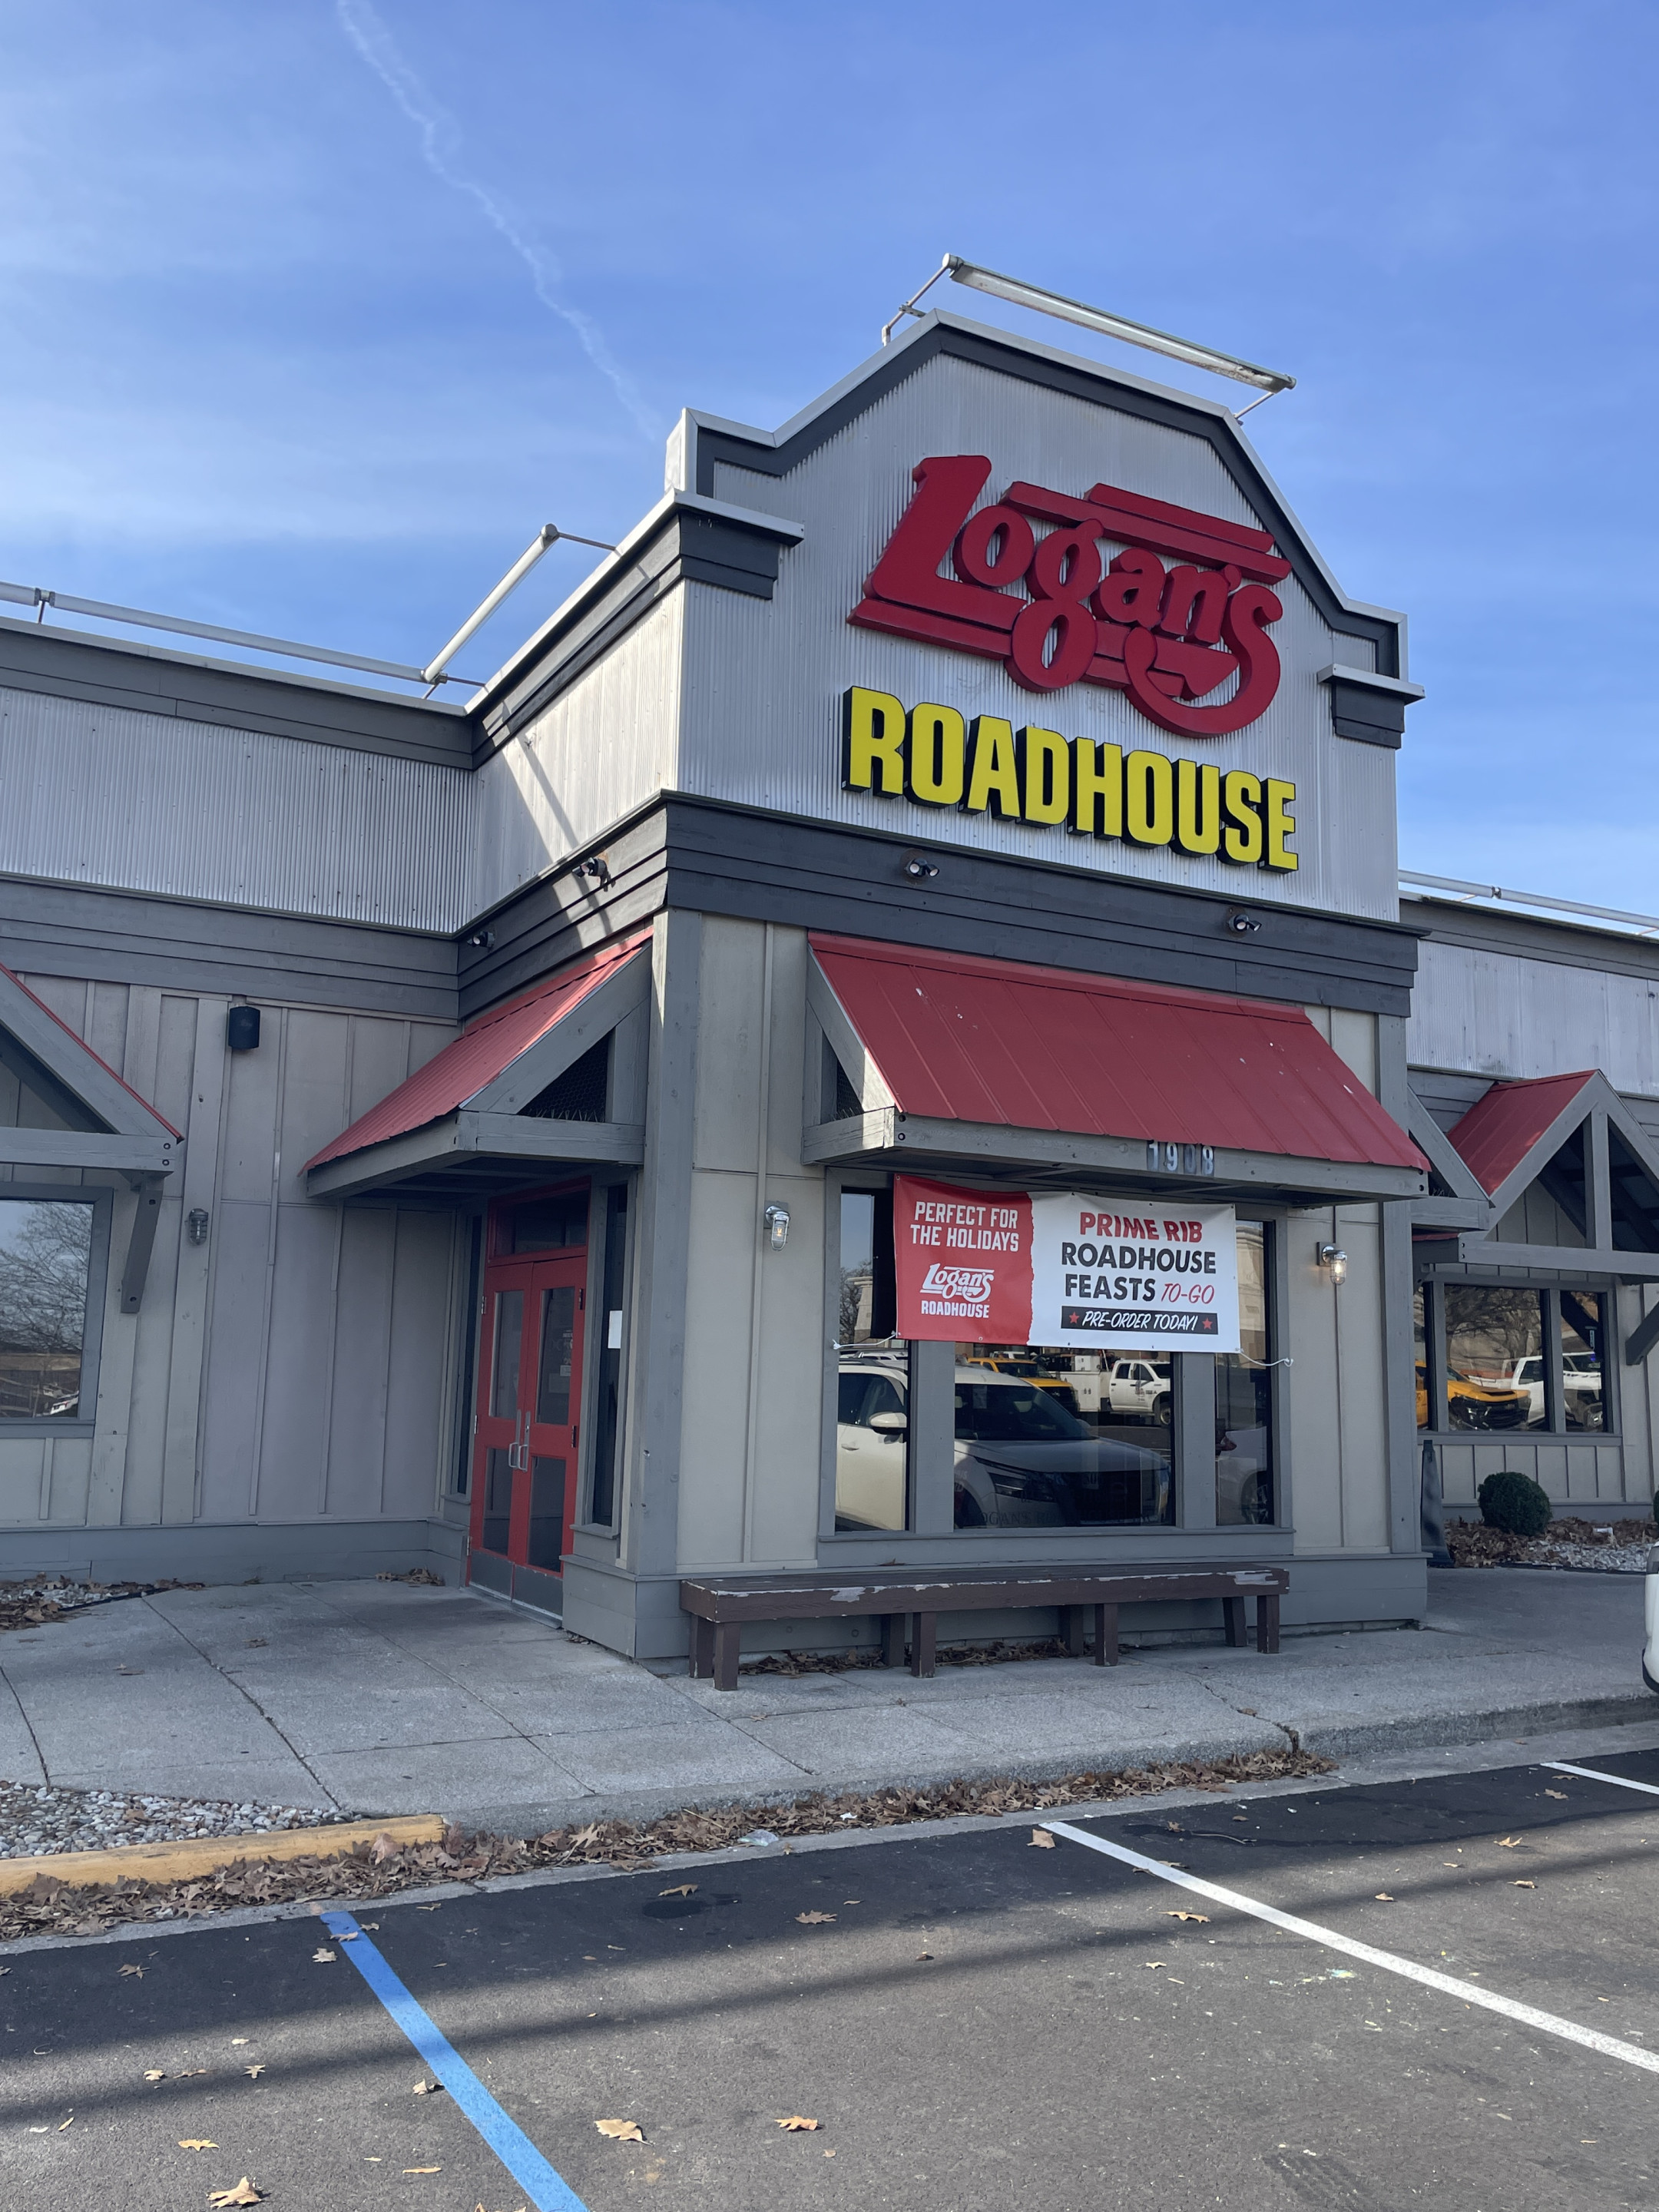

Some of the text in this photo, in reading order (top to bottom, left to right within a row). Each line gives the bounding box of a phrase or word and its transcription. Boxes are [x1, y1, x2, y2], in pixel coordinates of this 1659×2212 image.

[847, 455, 1291, 738] Logan's
[843, 686, 1299, 874] ROADHOUSE
[1147, 1140, 1214, 1176] 1908
[914, 1201, 1018, 1229] PERFECT FOR
[1080, 1212, 1203, 1243] PRIME RIB
[910, 1224, 1019, 1252] THE HOLIDAYS
[1061, 1242, 1217, 1274] ROADHOUSE
[919, 1263, 995, 1303] Logan's
[1065, 1273, 1214, 1304] FEASTS TO-GO
[921, 1300, 990, 1318] ROADHOUSE
[1082, 1310, 1198, 1330] PRE-ORDER TODAY!
